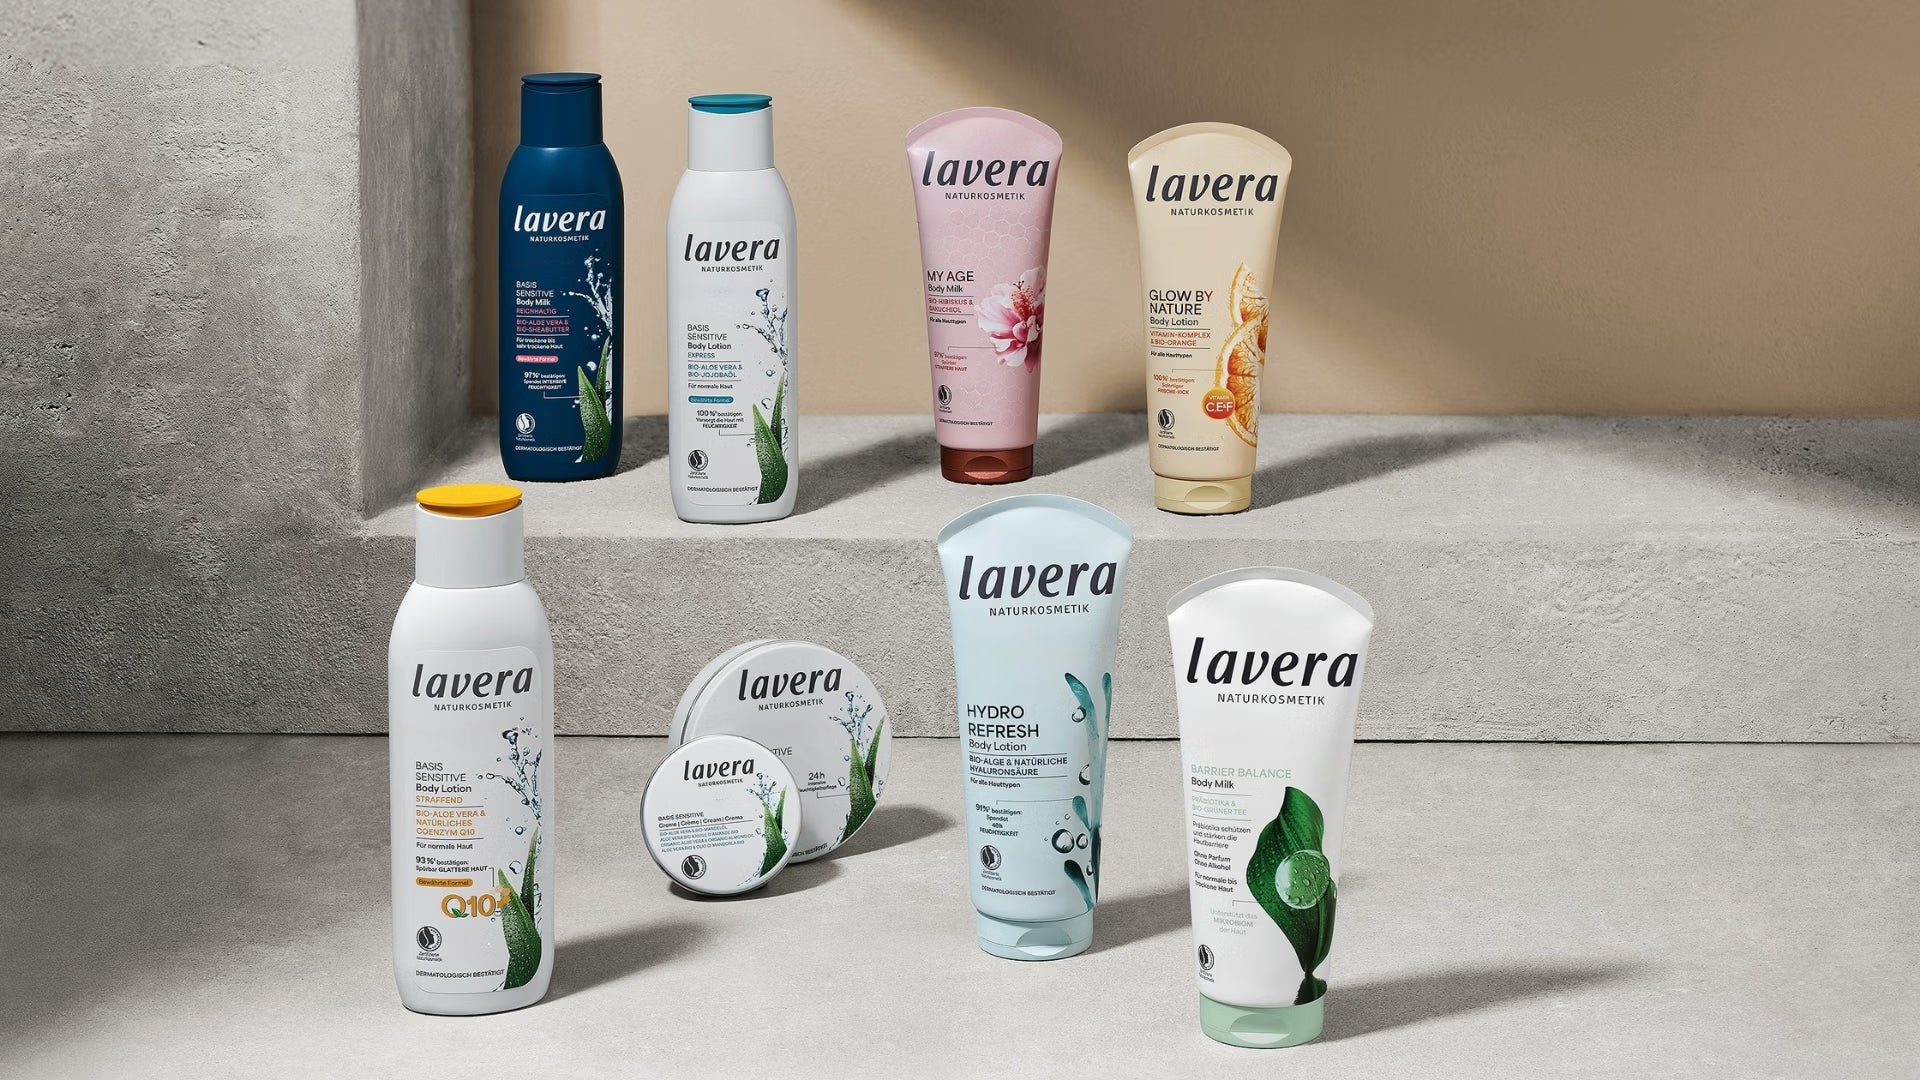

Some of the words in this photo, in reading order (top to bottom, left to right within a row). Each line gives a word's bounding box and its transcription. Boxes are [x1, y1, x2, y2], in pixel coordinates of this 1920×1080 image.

[922, 151, 1049, 186] lavera
[1146, 166, 1278, 202] lavera
[945, 192, 1025, 200] NATURKOSMETIK
[1171, 208, 1254, 216] NATURKOSMETIK
[514, 205, 606, 232] lavera
[684, 234, 780, 261] lavera
[927, 271, 944, 282] MY
[947, 271, 974, 282] AGE
[928, 284, 945, 294] Body
[1149, 289, 1191, 302] GLOW
[1196, 291, 1213, 302] BY
[516, 298, 533, 306] Body
[1150, 303, 1202, 315] NATURE
[1150, 317, 1169, 327] Body
[1172, 318, 1198, 326] Lotion
[688, 342, 706, 351] Body
[959, 555, 1117, 600] lavera
[990, 604, 1089, 616] NATURKOSMETIK
[1187, 637, 1358, 687] lavera
[412, 664, 533, 698] lavera
[739, 668, 842, 700] lavera
[759, 698, 824, 711] NATURKOSMETIK
[1218, 693, 1325, 705] NATURKOSMETIK
[434, 701, 512, 711] NATURKOSMETIK
[967, 704, 1024, 719] HYDRO
[968, 723, 1039, 738] REFRESH
[969, 739, 991, 752] Body
[994, 742, 1027, 751] Lotion
[771, 747, 792, 756] TIVE
[416, 762, 443, 770] BASIS
[969, 755, 1004, 766] BIO-ALGE
[1014, 757, 1067, 766] NATÜRLICHE
[684, 759, 754, 780] lavera
[970, 765, 1038, 776] HYALURONSÄURE
[1191, 764, 1234, 776] BARRIER
[1238, 768, 1291, 778] BALANCE
[416, 772, 466, 781] SENSITIVE
[698, 779, 743, 787] NATURKOSMETIK
[1191, 777, 1213, 789] Body
[1215, 780, 1234, 789] Milk
[416, 784, 439, 794] Body
[416, 819, 472, 827] NATÜRLICHES
[416, 828, 457, 836] COENZYM
[980, 827, 1019, 837] FEUCHTIGKEIT
[1204, 832, 1225, 840] stärken
[1209, 854, 1230, 862] Parfum
[1208, 862, 1231, 870] Alkohol
[441, 894, 496, 918] Q10
[1214, 917, 1253, 927] MIKROBIOM
[416, 970, 472, 978] DERMATOLOGISCH
[473, 969, 504, 977] BESTÄTIGT
